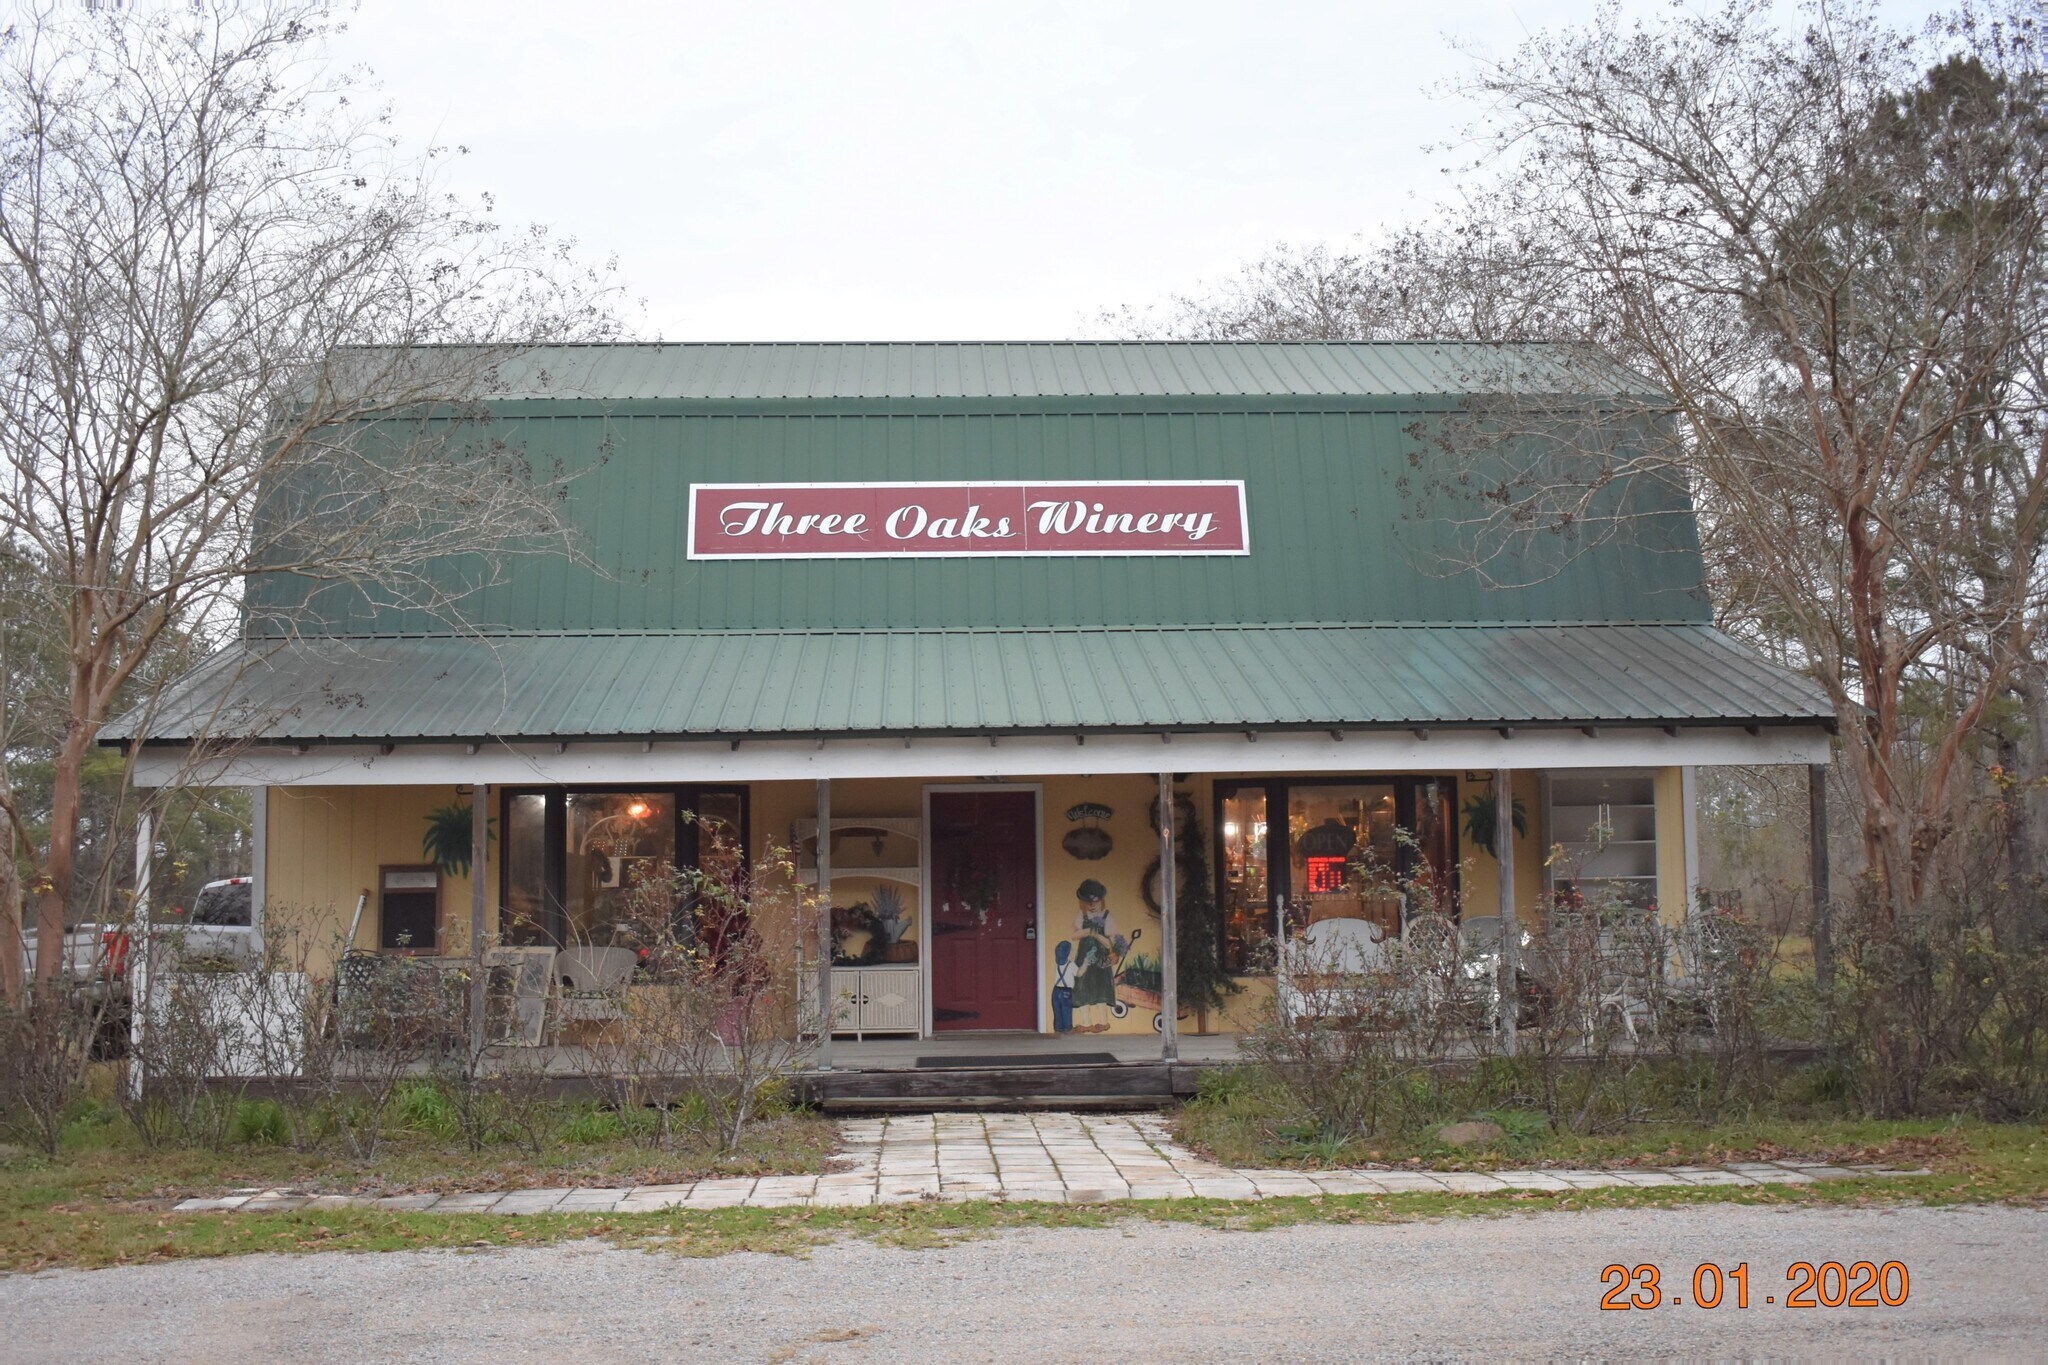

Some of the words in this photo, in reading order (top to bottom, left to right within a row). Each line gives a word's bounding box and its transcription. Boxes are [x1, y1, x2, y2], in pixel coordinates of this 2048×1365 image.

[719, 501, 869, 537] Three
[885, 504, 1016, 540] Oaks
[1026, 500, 1218, 541] Winery
[1302, 832, 1348, 850] OPEN
